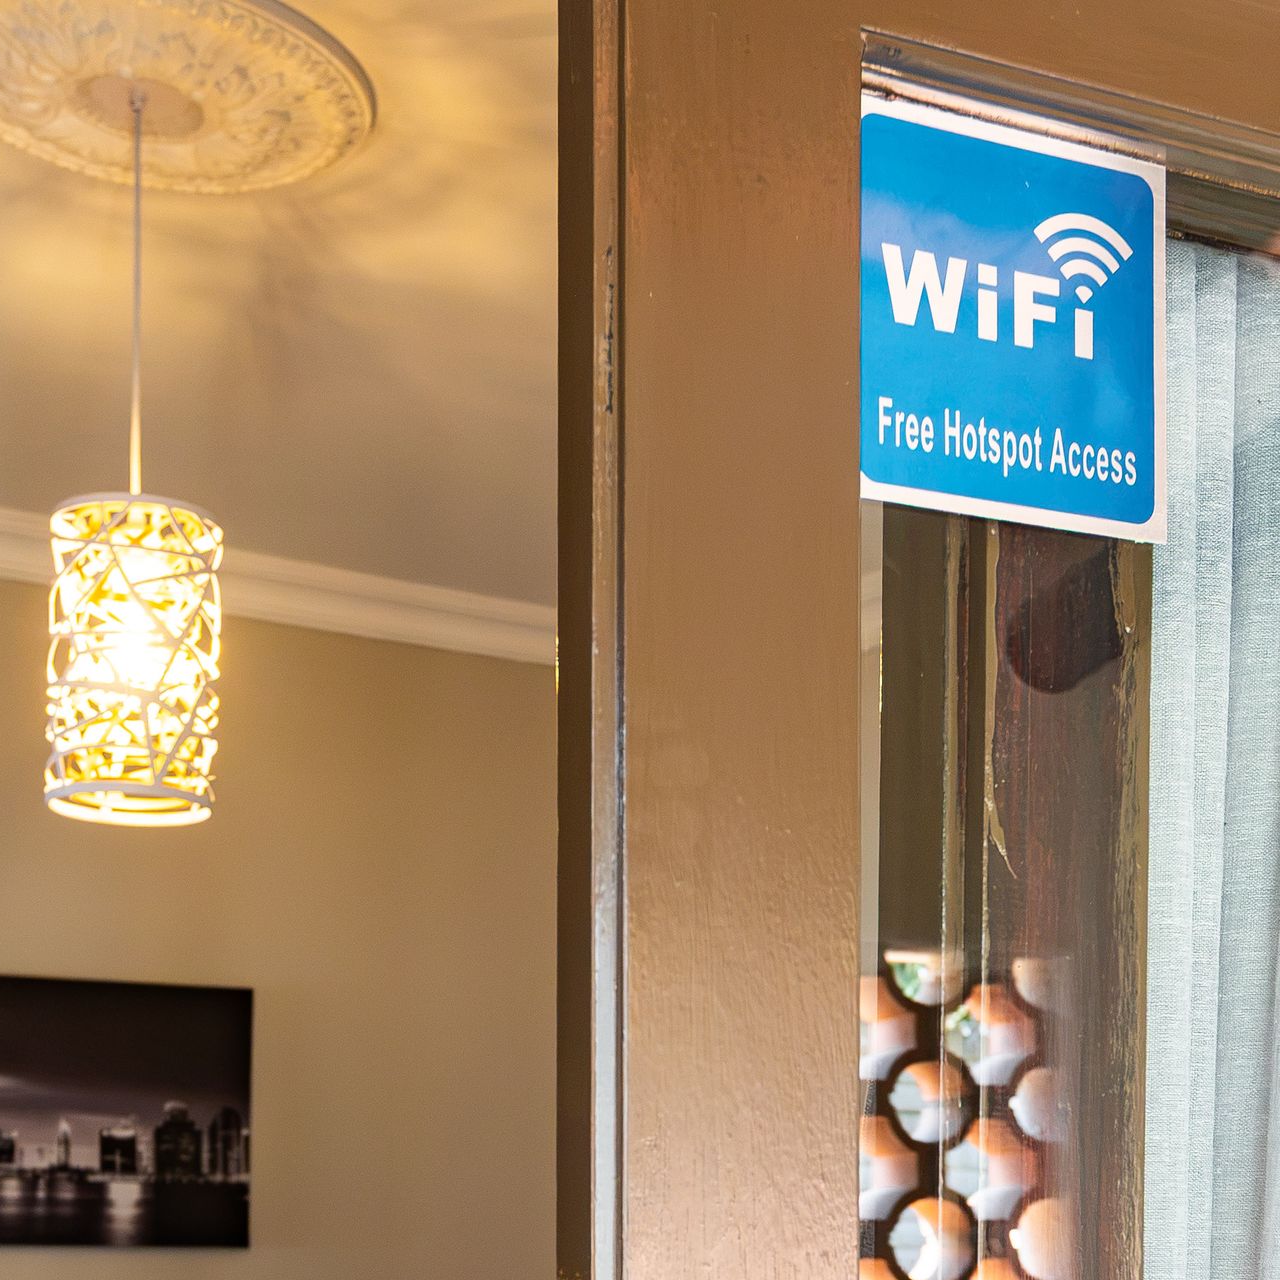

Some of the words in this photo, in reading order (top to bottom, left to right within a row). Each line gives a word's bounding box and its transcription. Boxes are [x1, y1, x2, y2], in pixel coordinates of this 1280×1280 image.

[881, 242, 1094, 360] WiFi
[878, 396, 935, 453] Free
[944, 407, 1043, 477] Hotspot
[1049, 427, 1137, 486] Access
